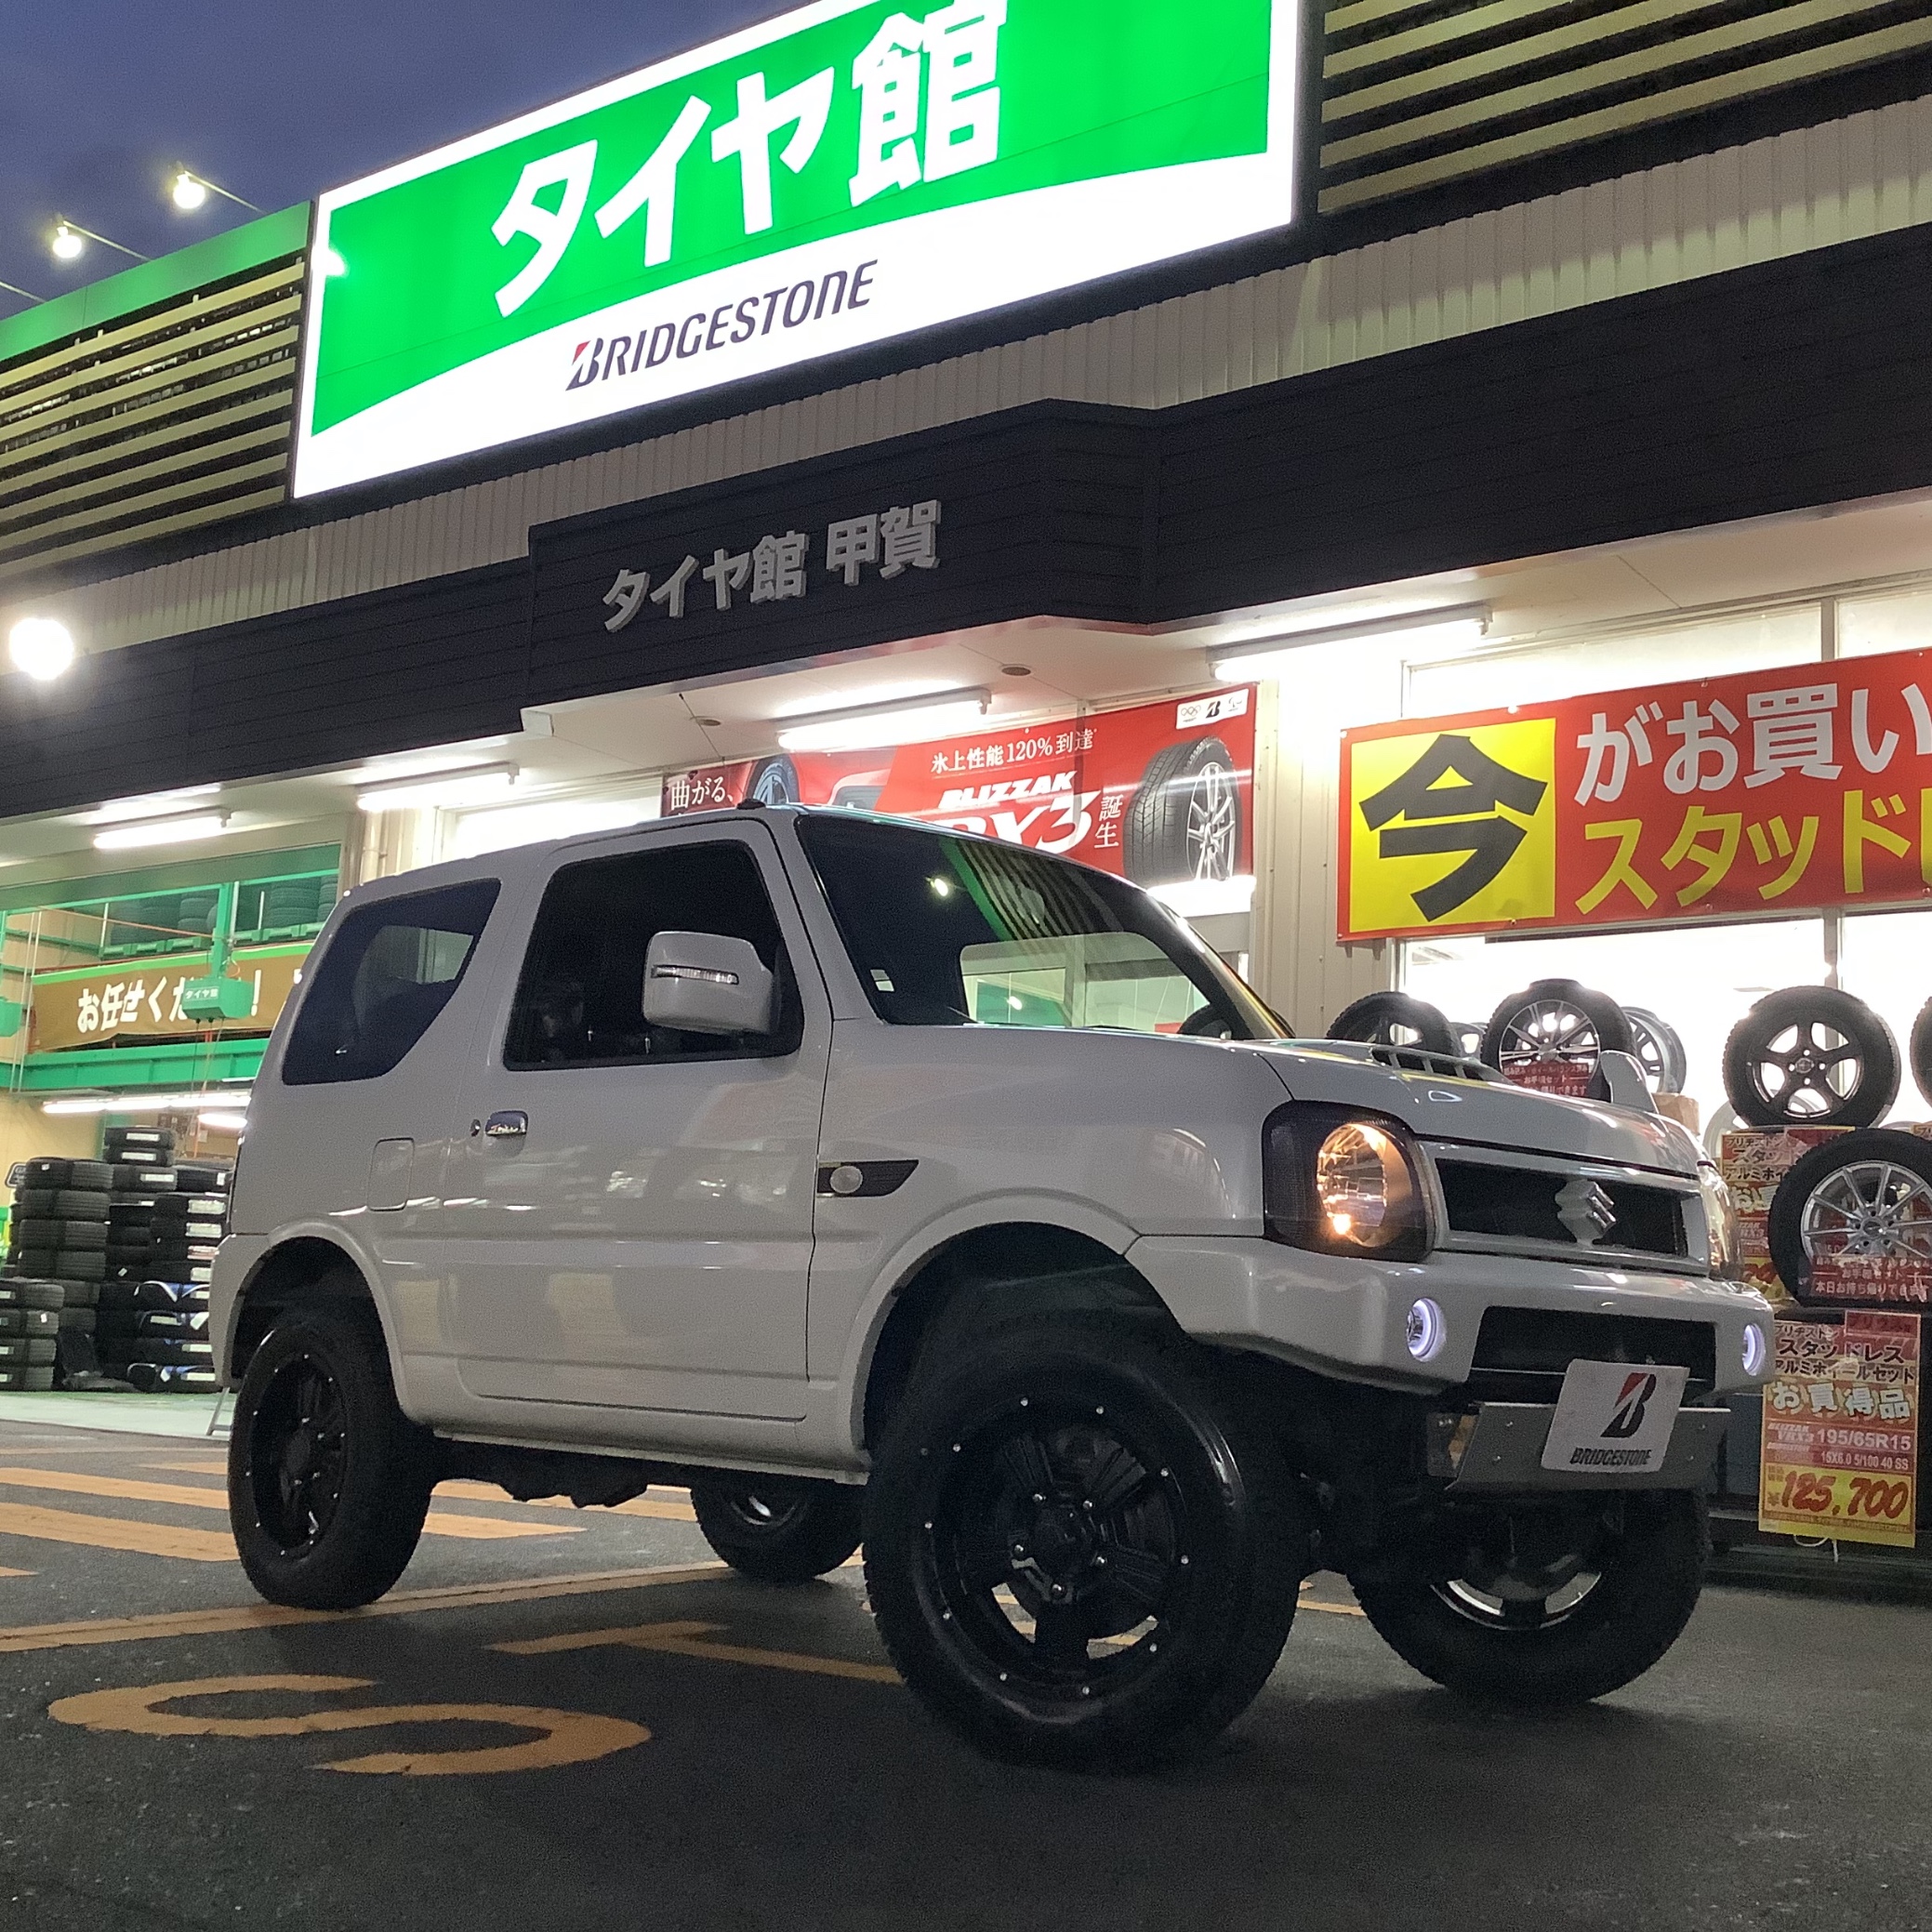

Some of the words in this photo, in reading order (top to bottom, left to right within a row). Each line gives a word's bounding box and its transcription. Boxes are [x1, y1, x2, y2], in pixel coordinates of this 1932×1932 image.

[491, 0, 1008, 318] タイヤ館
[565, 259, 878, 391] BRIDGESTONE
[602, 530, 809, 633] タイヤ館
[826, 499, 941, 587] 甲賀
[1574, 682, 1932, 806] がお買い
[1358, 734, 1548, 922] 今
[1575, 787, 1932, 915] スタッド
[1569, 1448, 1652, 1466] BRIDGESTONE
[1817, 1428, 1912, 1451] 195/65R15
